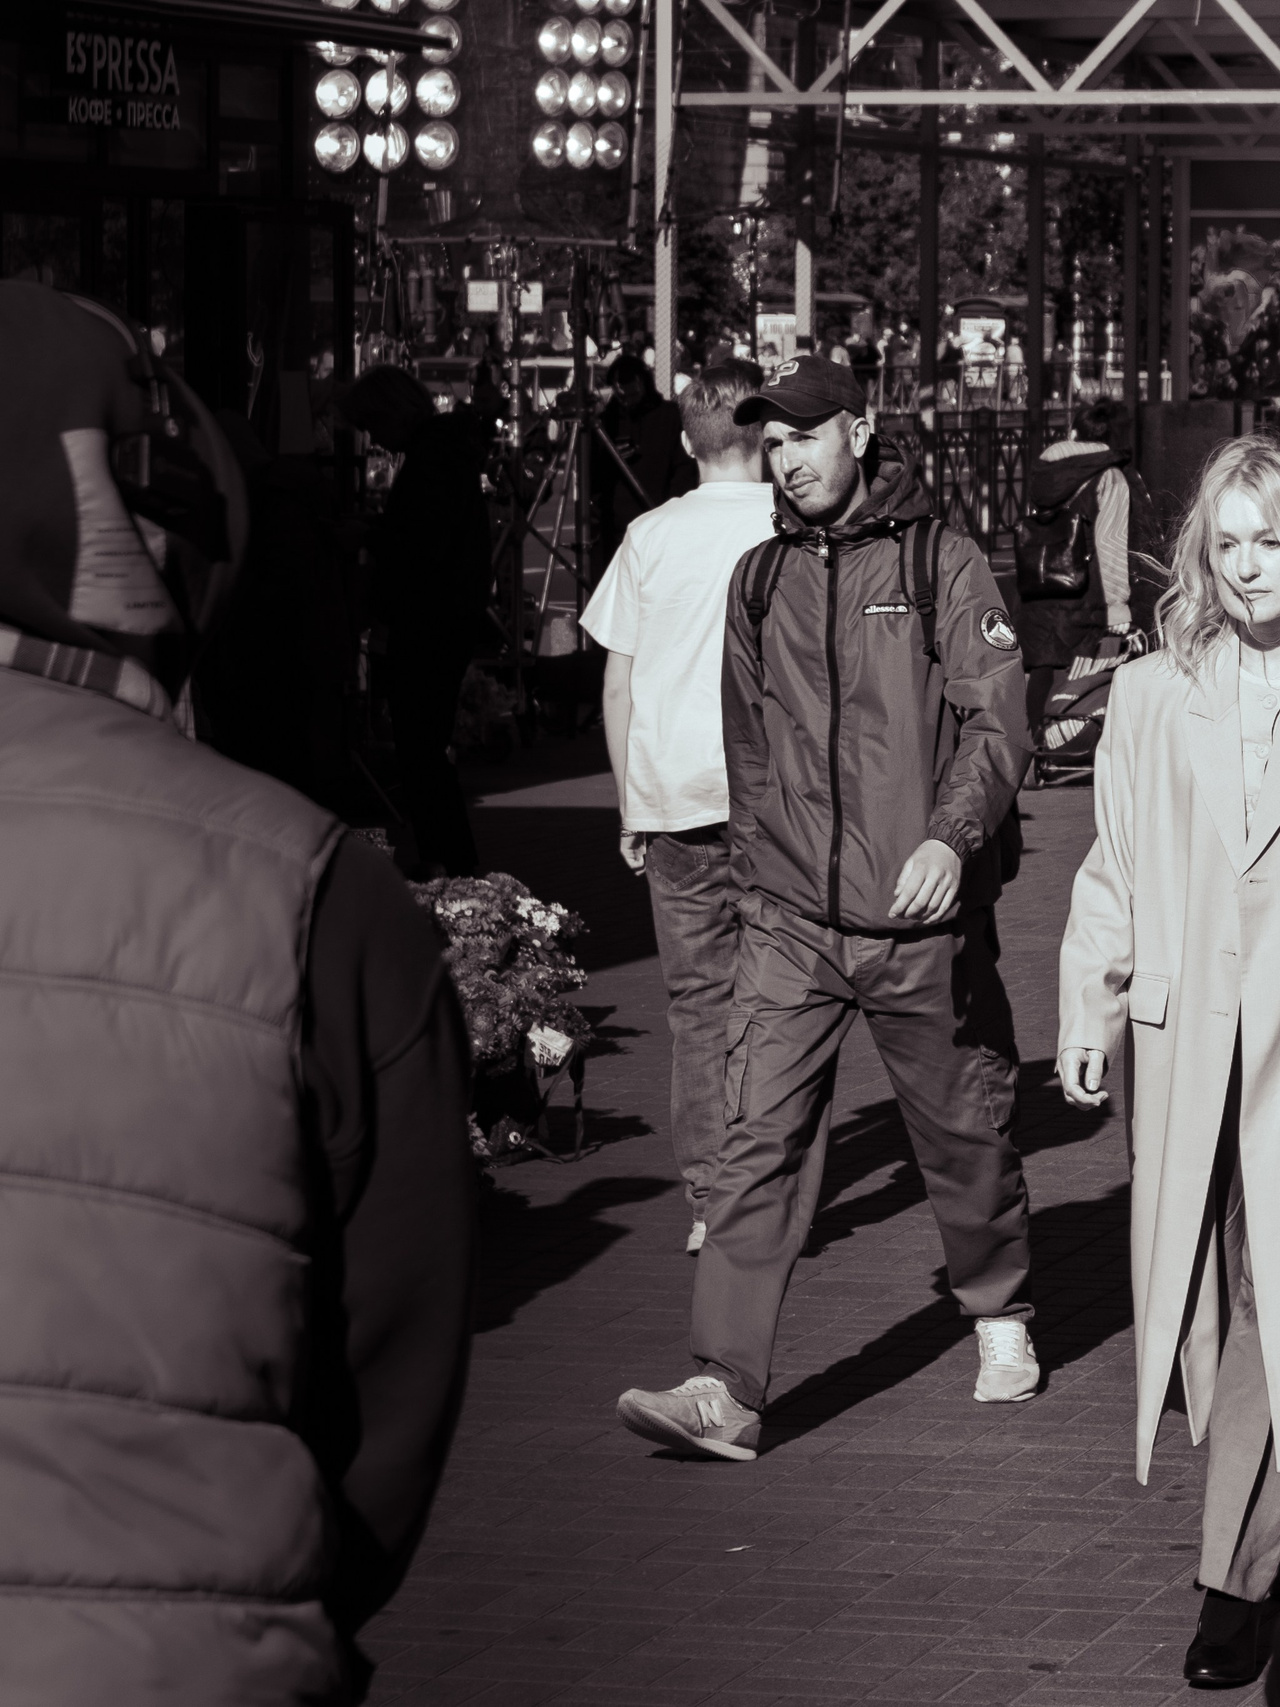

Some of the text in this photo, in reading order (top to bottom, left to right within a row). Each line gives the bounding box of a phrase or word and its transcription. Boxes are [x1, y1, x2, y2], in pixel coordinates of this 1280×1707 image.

[65, 30, 180, 96] ES'PRESSA
[68, 95, 181, 130] КОФЕ ПРЕССА
[864, 605, 896, 615] ellesse
[696, 1399, 727, 1428] N
